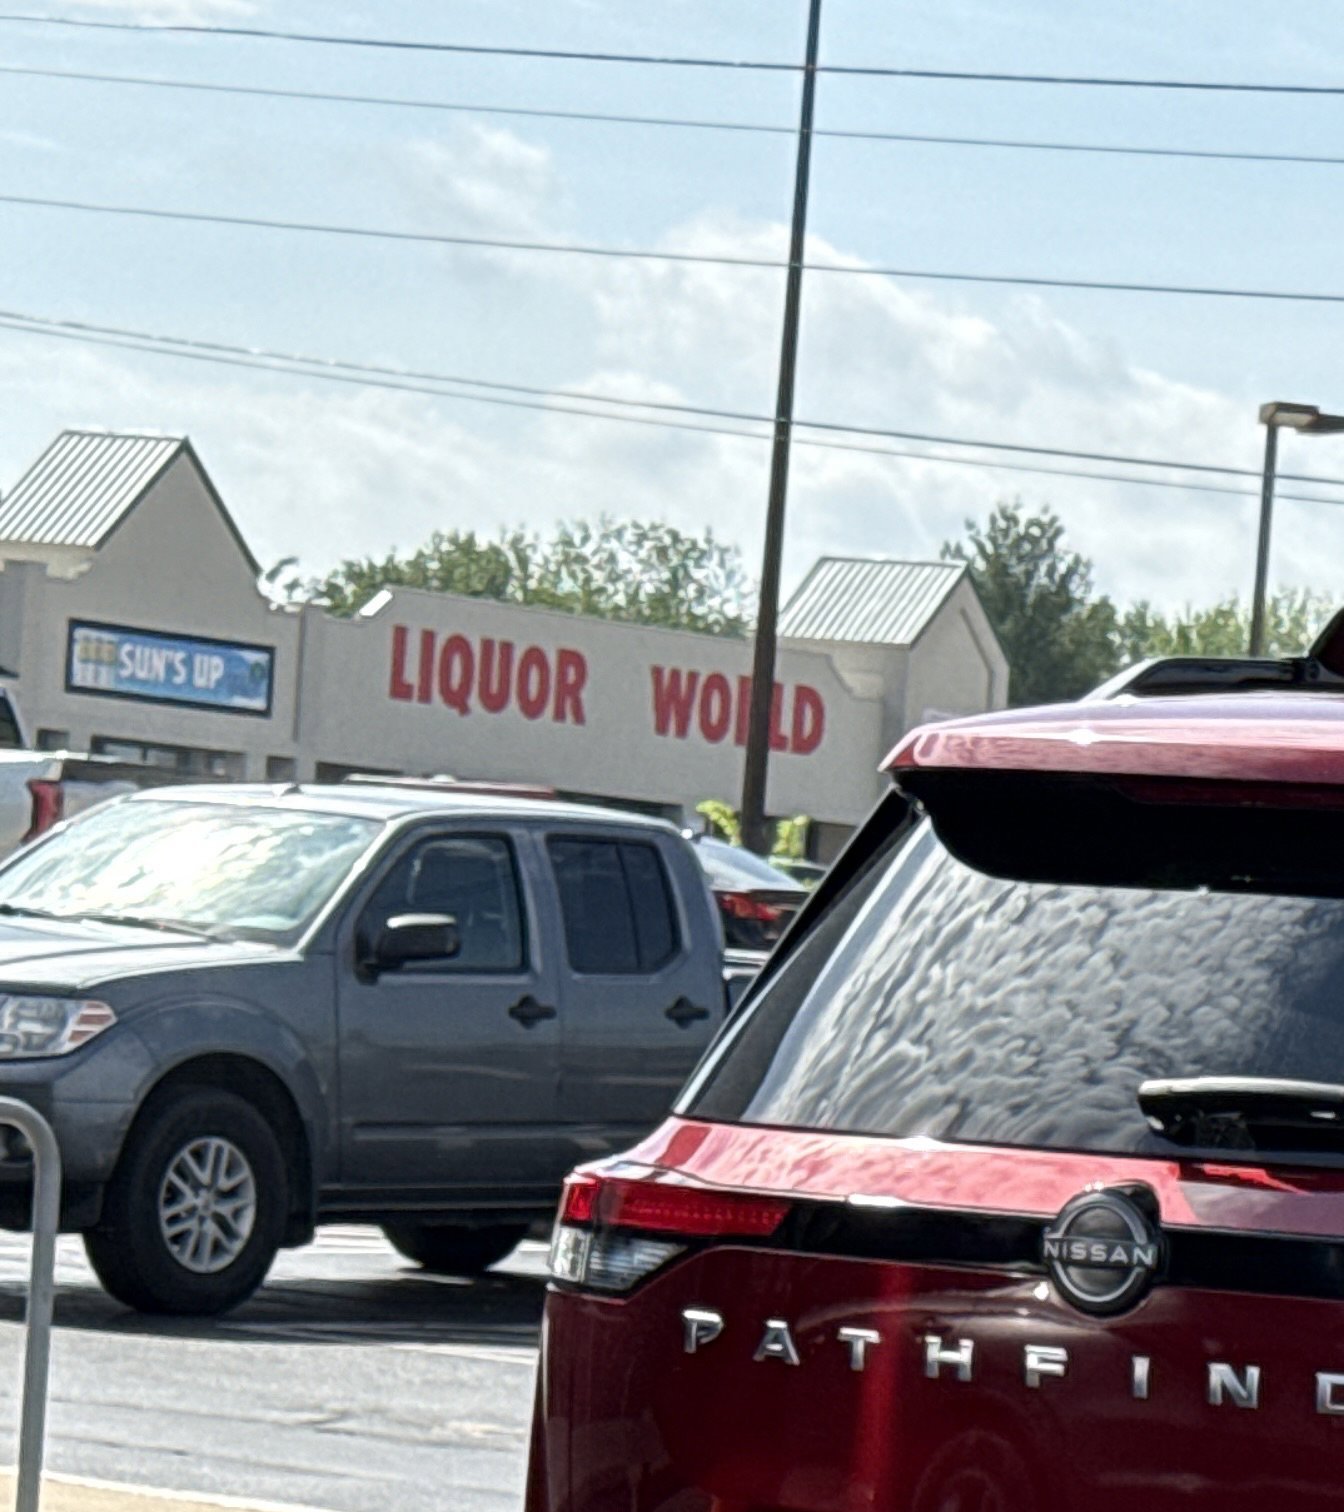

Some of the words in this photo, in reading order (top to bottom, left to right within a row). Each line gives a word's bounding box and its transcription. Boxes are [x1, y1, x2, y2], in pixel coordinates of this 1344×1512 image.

[119, 643, 187, 685] SUN'S
[192, 654, 225, 689] UP
[389, 624, 588, 726] LIQUOR
[1043, 1240, 1156, 1265] NISSAN
